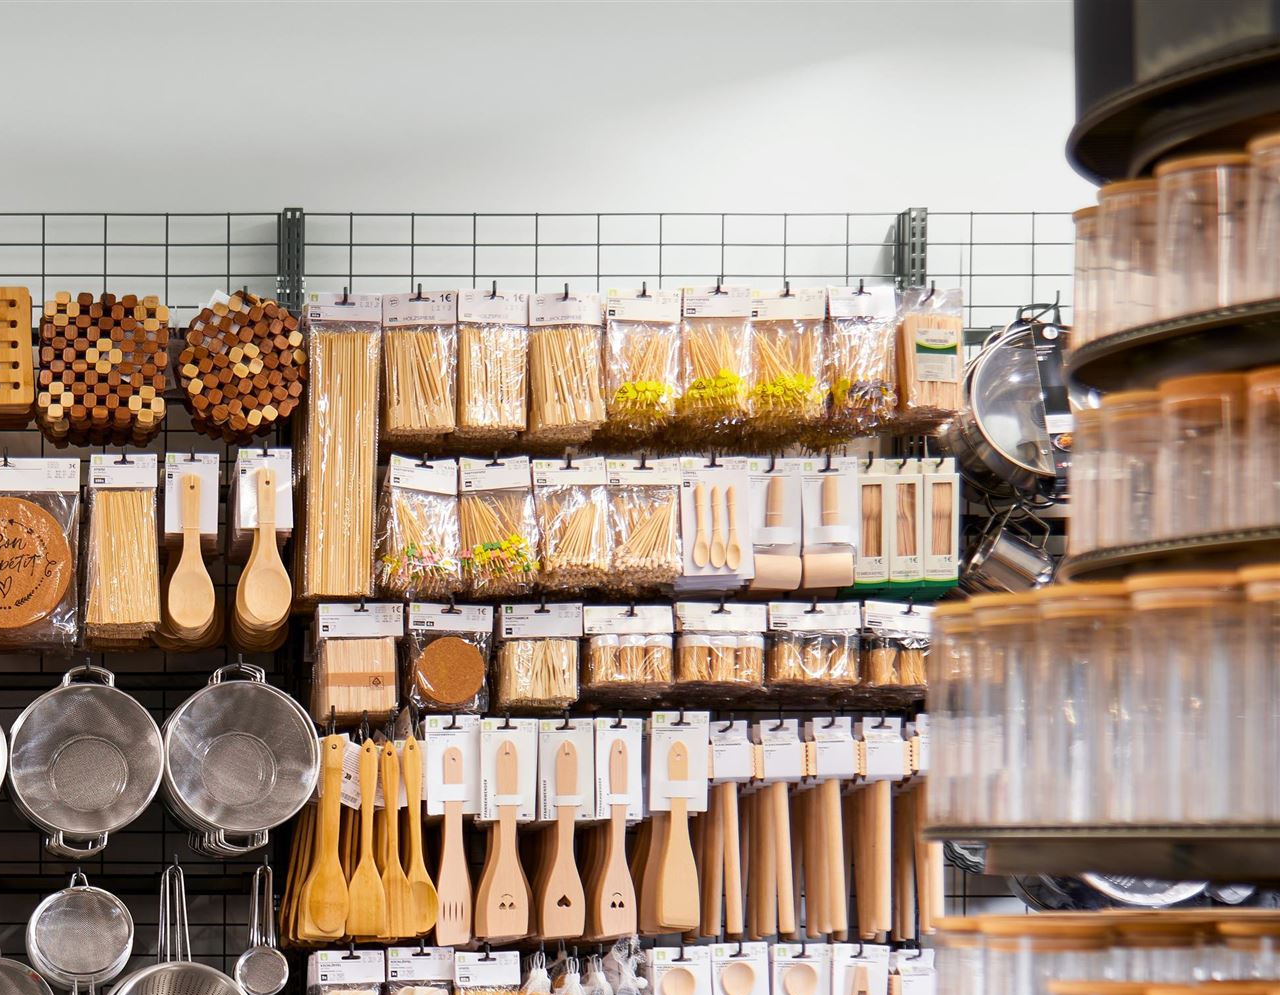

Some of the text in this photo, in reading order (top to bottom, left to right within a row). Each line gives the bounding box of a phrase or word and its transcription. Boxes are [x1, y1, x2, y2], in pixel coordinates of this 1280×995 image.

[439, 293, 452, 303] 1€
[513, 294, 524, 302] 1€
[391, 605, 401, 613] 1€
